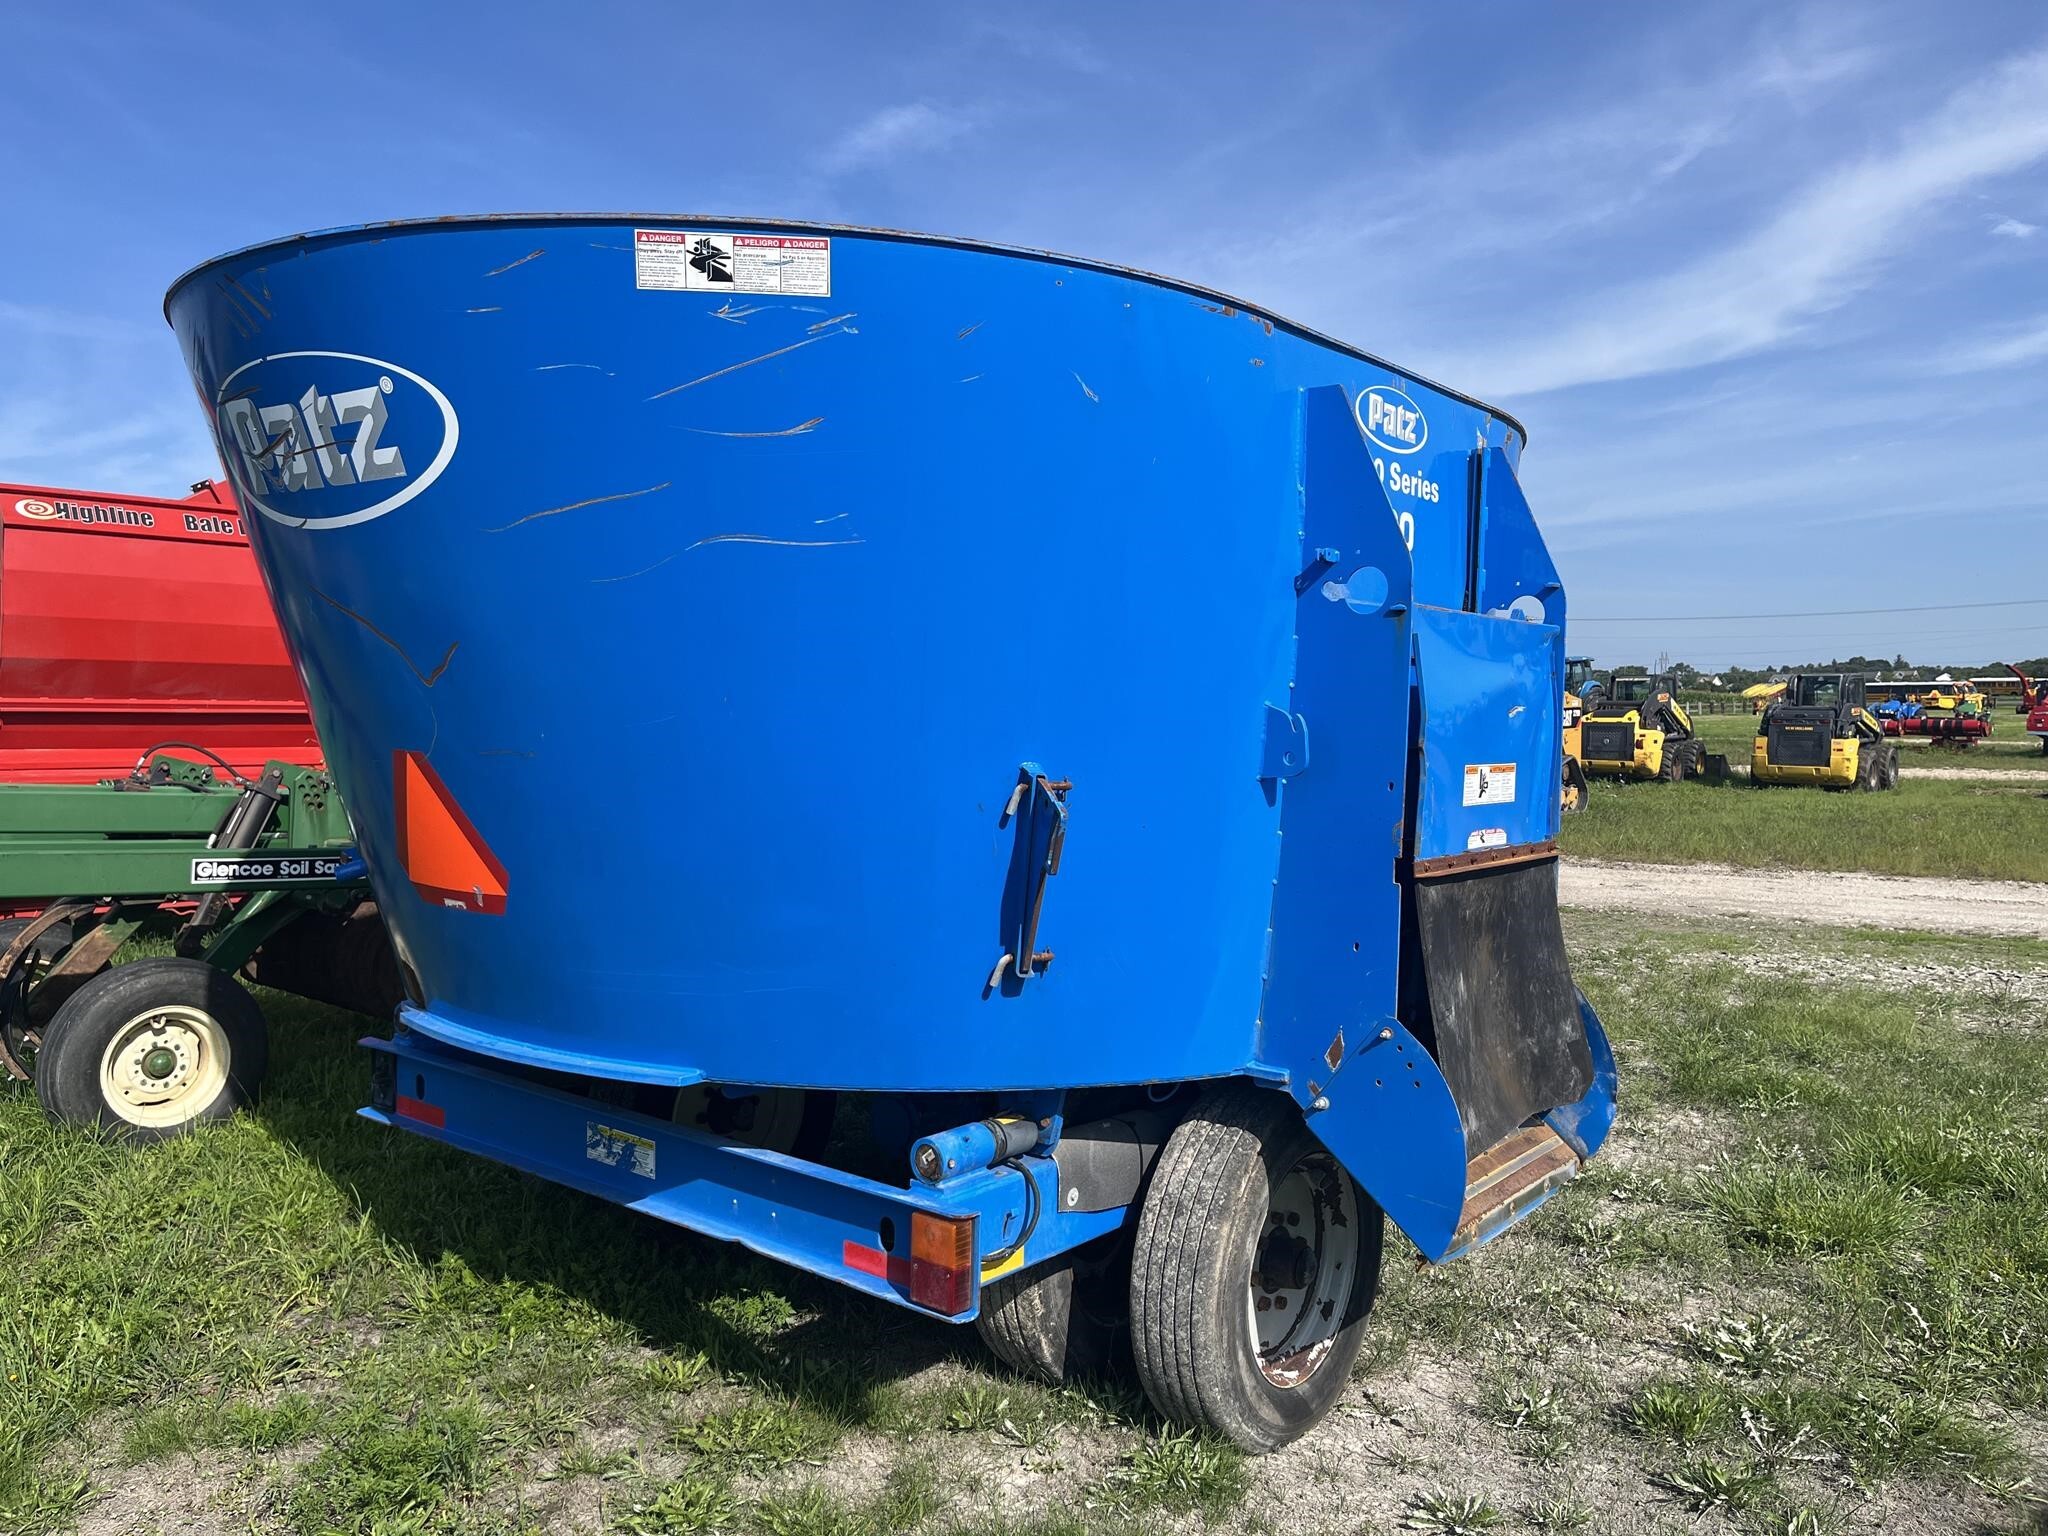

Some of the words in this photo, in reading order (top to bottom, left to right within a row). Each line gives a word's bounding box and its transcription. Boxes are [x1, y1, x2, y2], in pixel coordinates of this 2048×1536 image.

[649, 234, 682, 243] DANGER
[744, 239, 780, 247] PELIGRO
[792, 240, 826, 249] DANGER
[1368, 392, 1417, 445] Patz
[225, 384, 407, 495] Patz
[1389, 461, 1440, 504] Series
[54, 502, 154, 527] Highline
[183, 514, 233, 536] Bale
[197, 862, 274, 878] Glencoe
[279, 861, 310, 875] Soil
